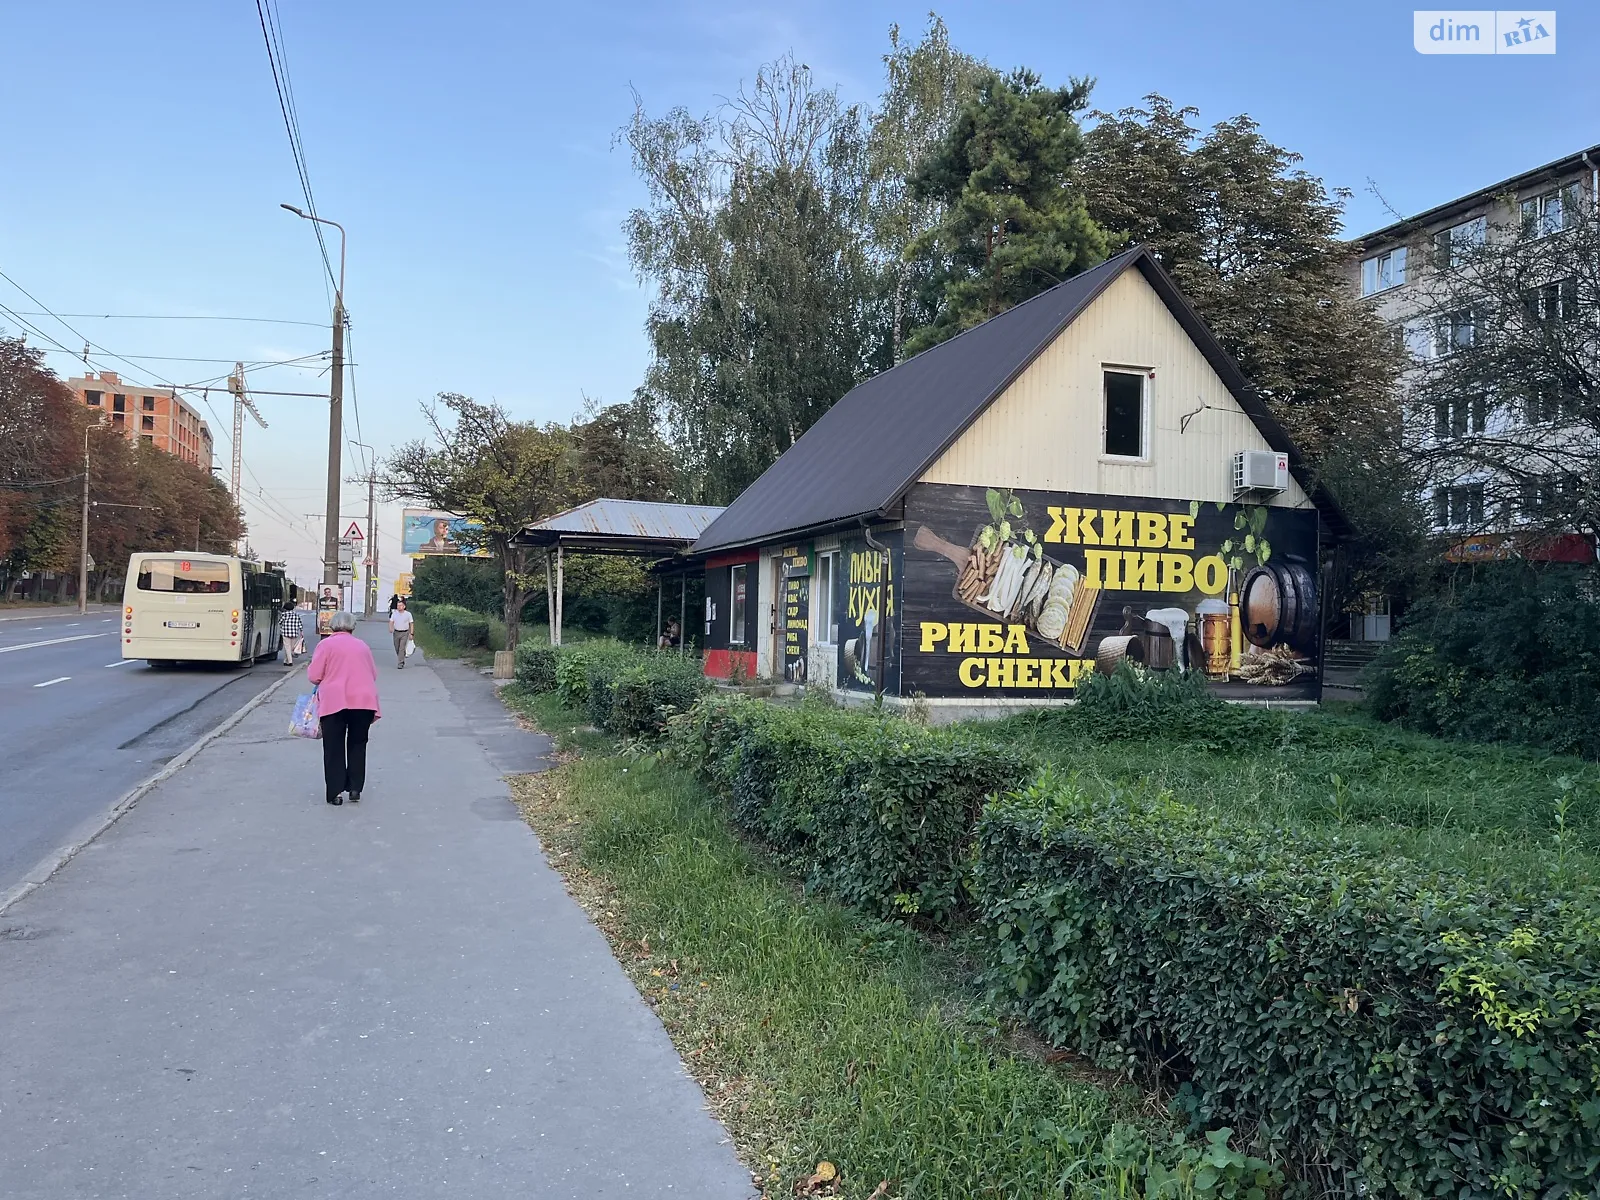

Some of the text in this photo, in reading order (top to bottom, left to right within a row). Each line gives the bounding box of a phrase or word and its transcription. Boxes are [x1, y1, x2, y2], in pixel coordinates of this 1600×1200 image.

[1044, 506, 1195, 550] ЖИВЕ
[1084, 549, 1229, 594] ПИВО
[920, 623, 1030, 654] РИБА
